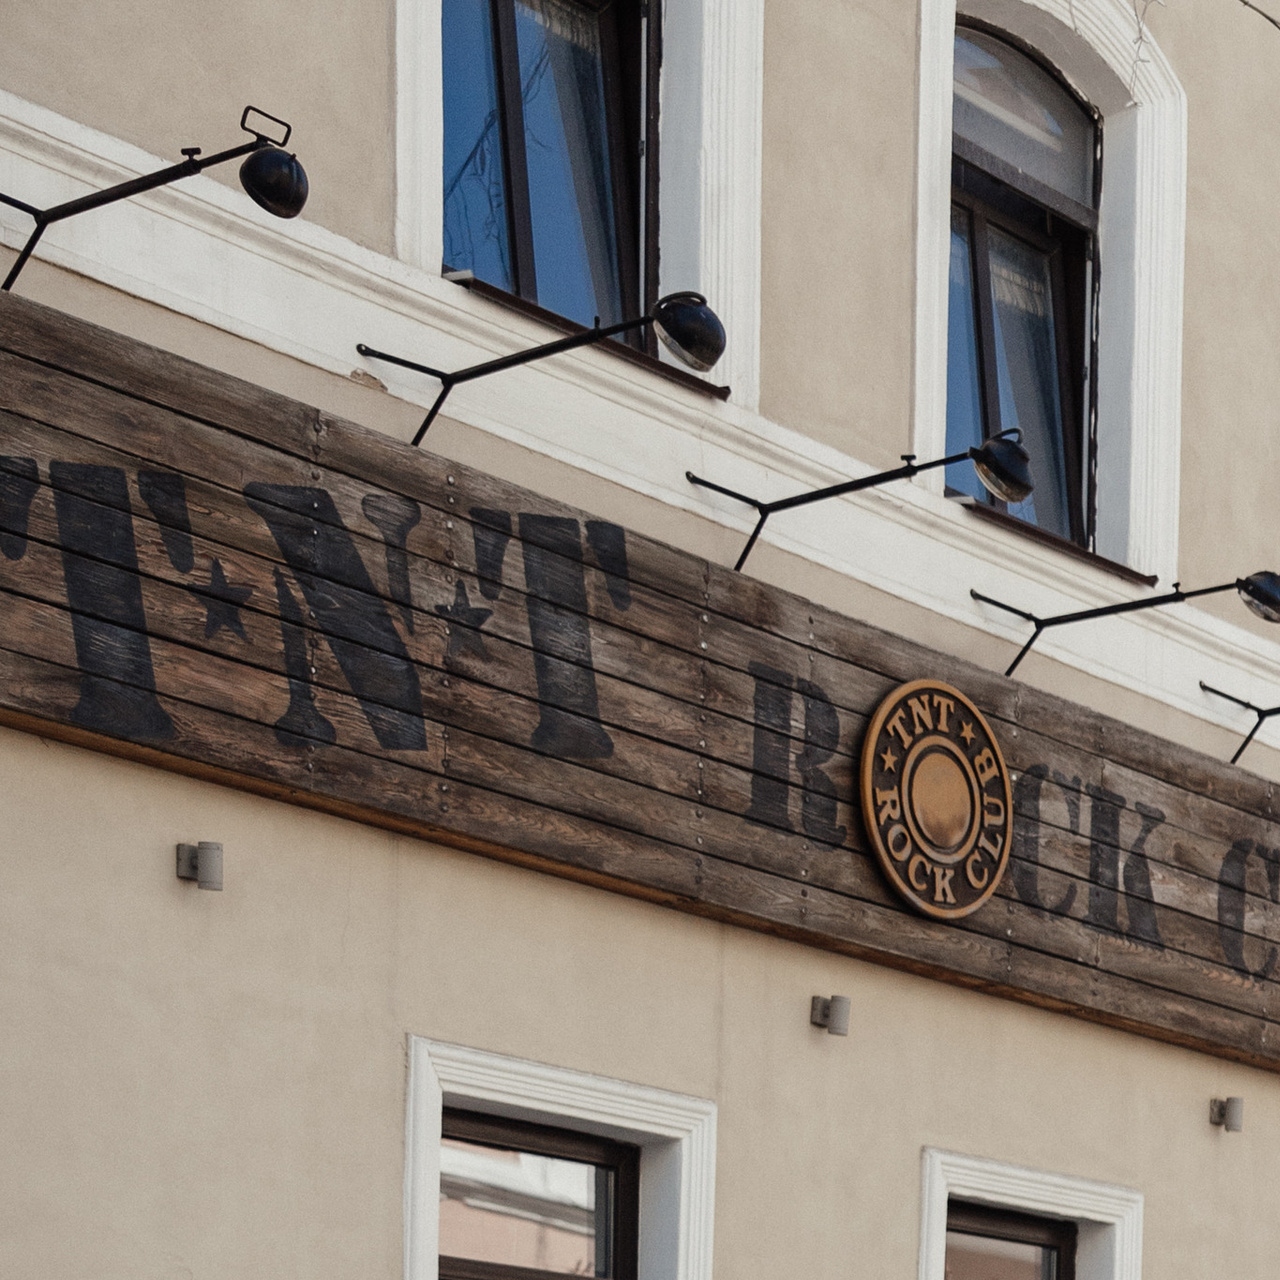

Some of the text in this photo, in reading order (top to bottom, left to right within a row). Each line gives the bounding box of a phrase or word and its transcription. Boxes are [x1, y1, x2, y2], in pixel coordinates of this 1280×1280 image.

[886, 693, 956, 752] TNT
[873, 746, 1006, 905] ROCK CLUB
